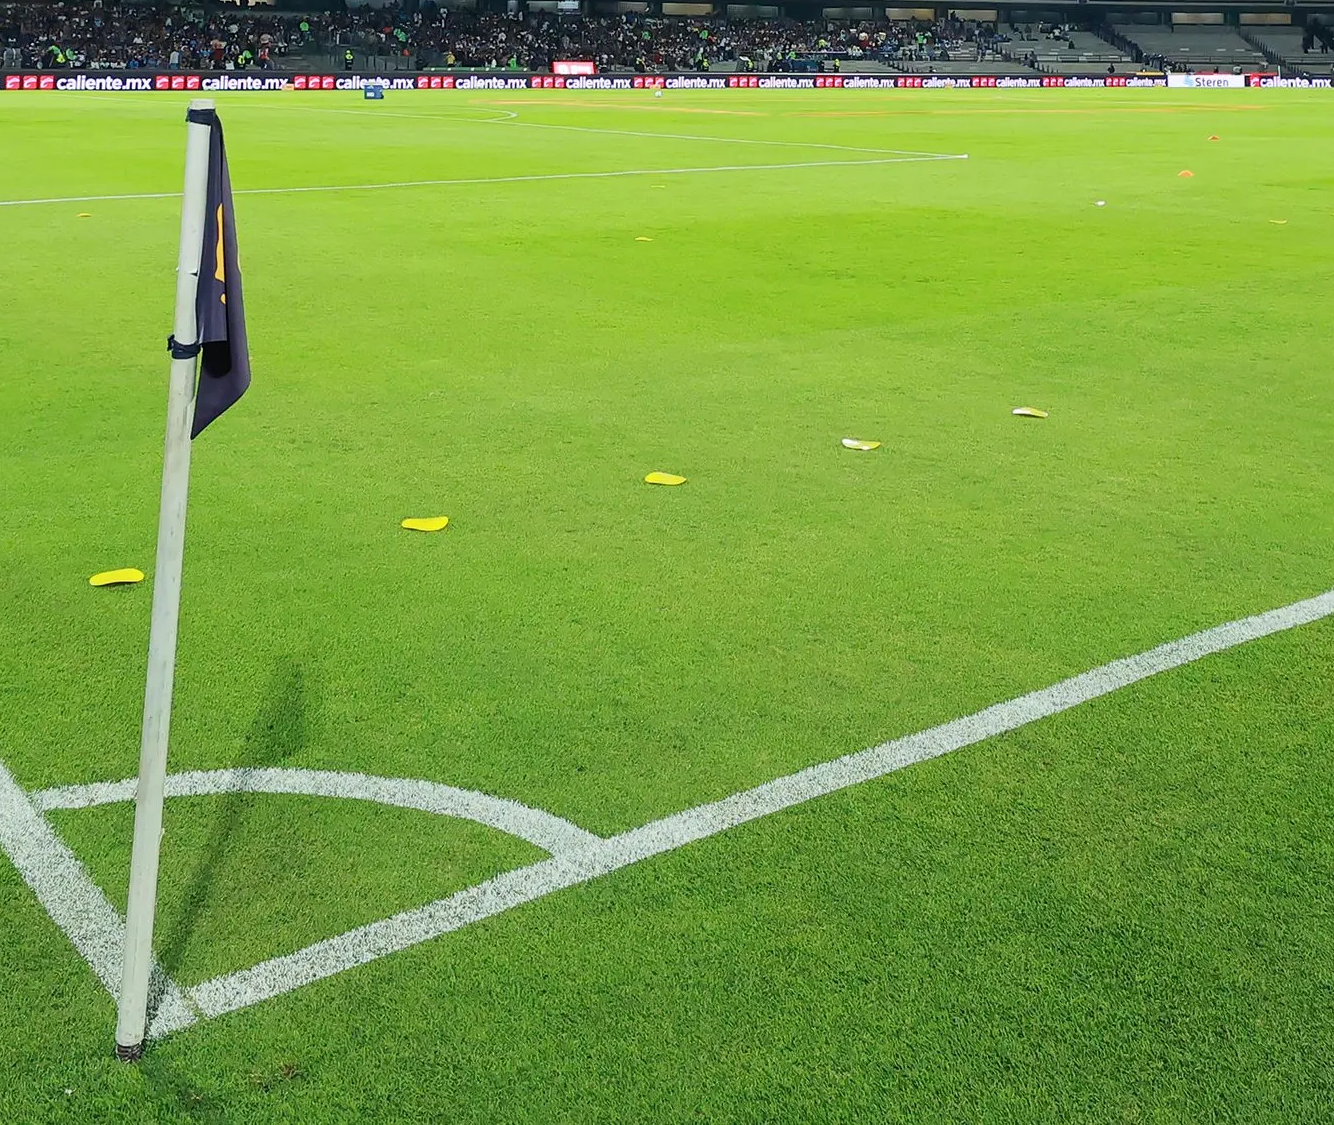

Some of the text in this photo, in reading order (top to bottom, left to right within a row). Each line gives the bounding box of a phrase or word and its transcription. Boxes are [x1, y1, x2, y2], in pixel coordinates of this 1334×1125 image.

[56, 75, 152, 90] caliente.mx
[202, 75, 289, 90] caliente.mx
[455, 76, 527, 89] caliente.mx
[566, 76, 631, 89] caliente.mx
[665, 76, 726, 88] caliente.mx
[758, 76, 814, 88] caliente.mx
[843, 76, 895, 88] caliente.mx
[1195, 77, 1229, 88] Steren
[1259, 76, 1332, 88] caliente.mx
